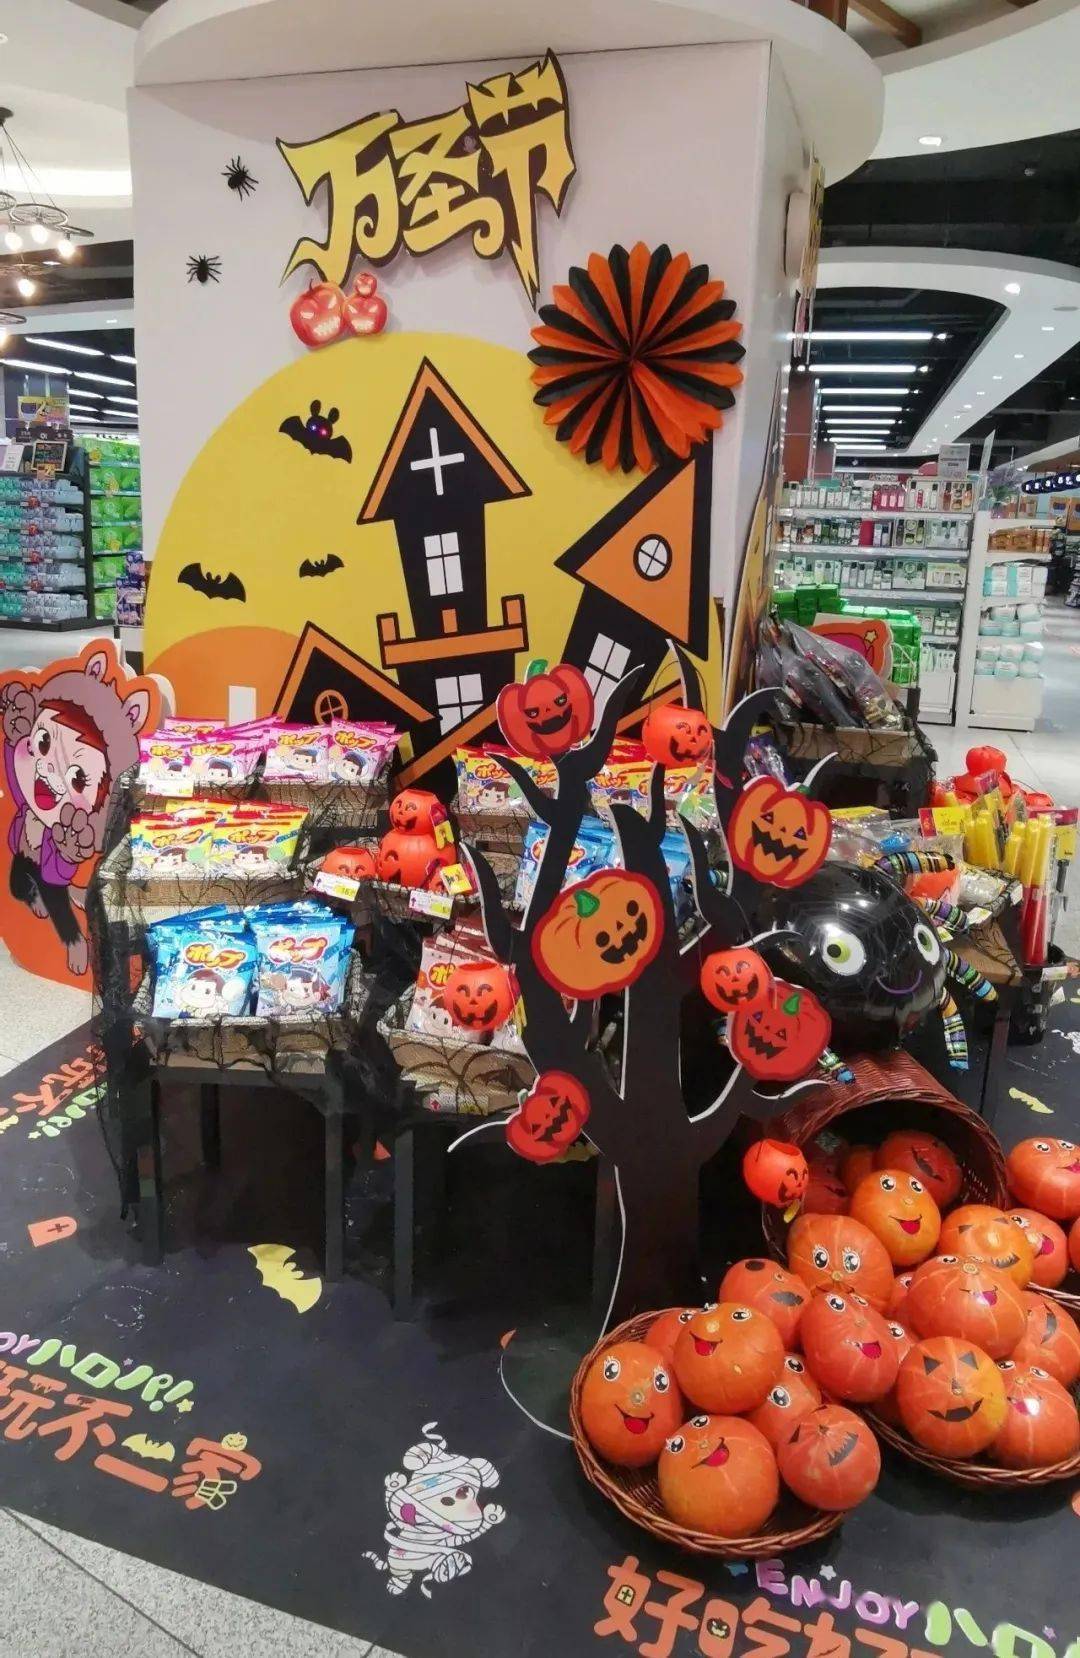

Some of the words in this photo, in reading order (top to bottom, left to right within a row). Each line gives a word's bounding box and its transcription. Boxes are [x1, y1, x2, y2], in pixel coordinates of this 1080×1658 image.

[276, 48, 577, 312] 万圣节
[756, 1559, 919, 1629] ENJOY
